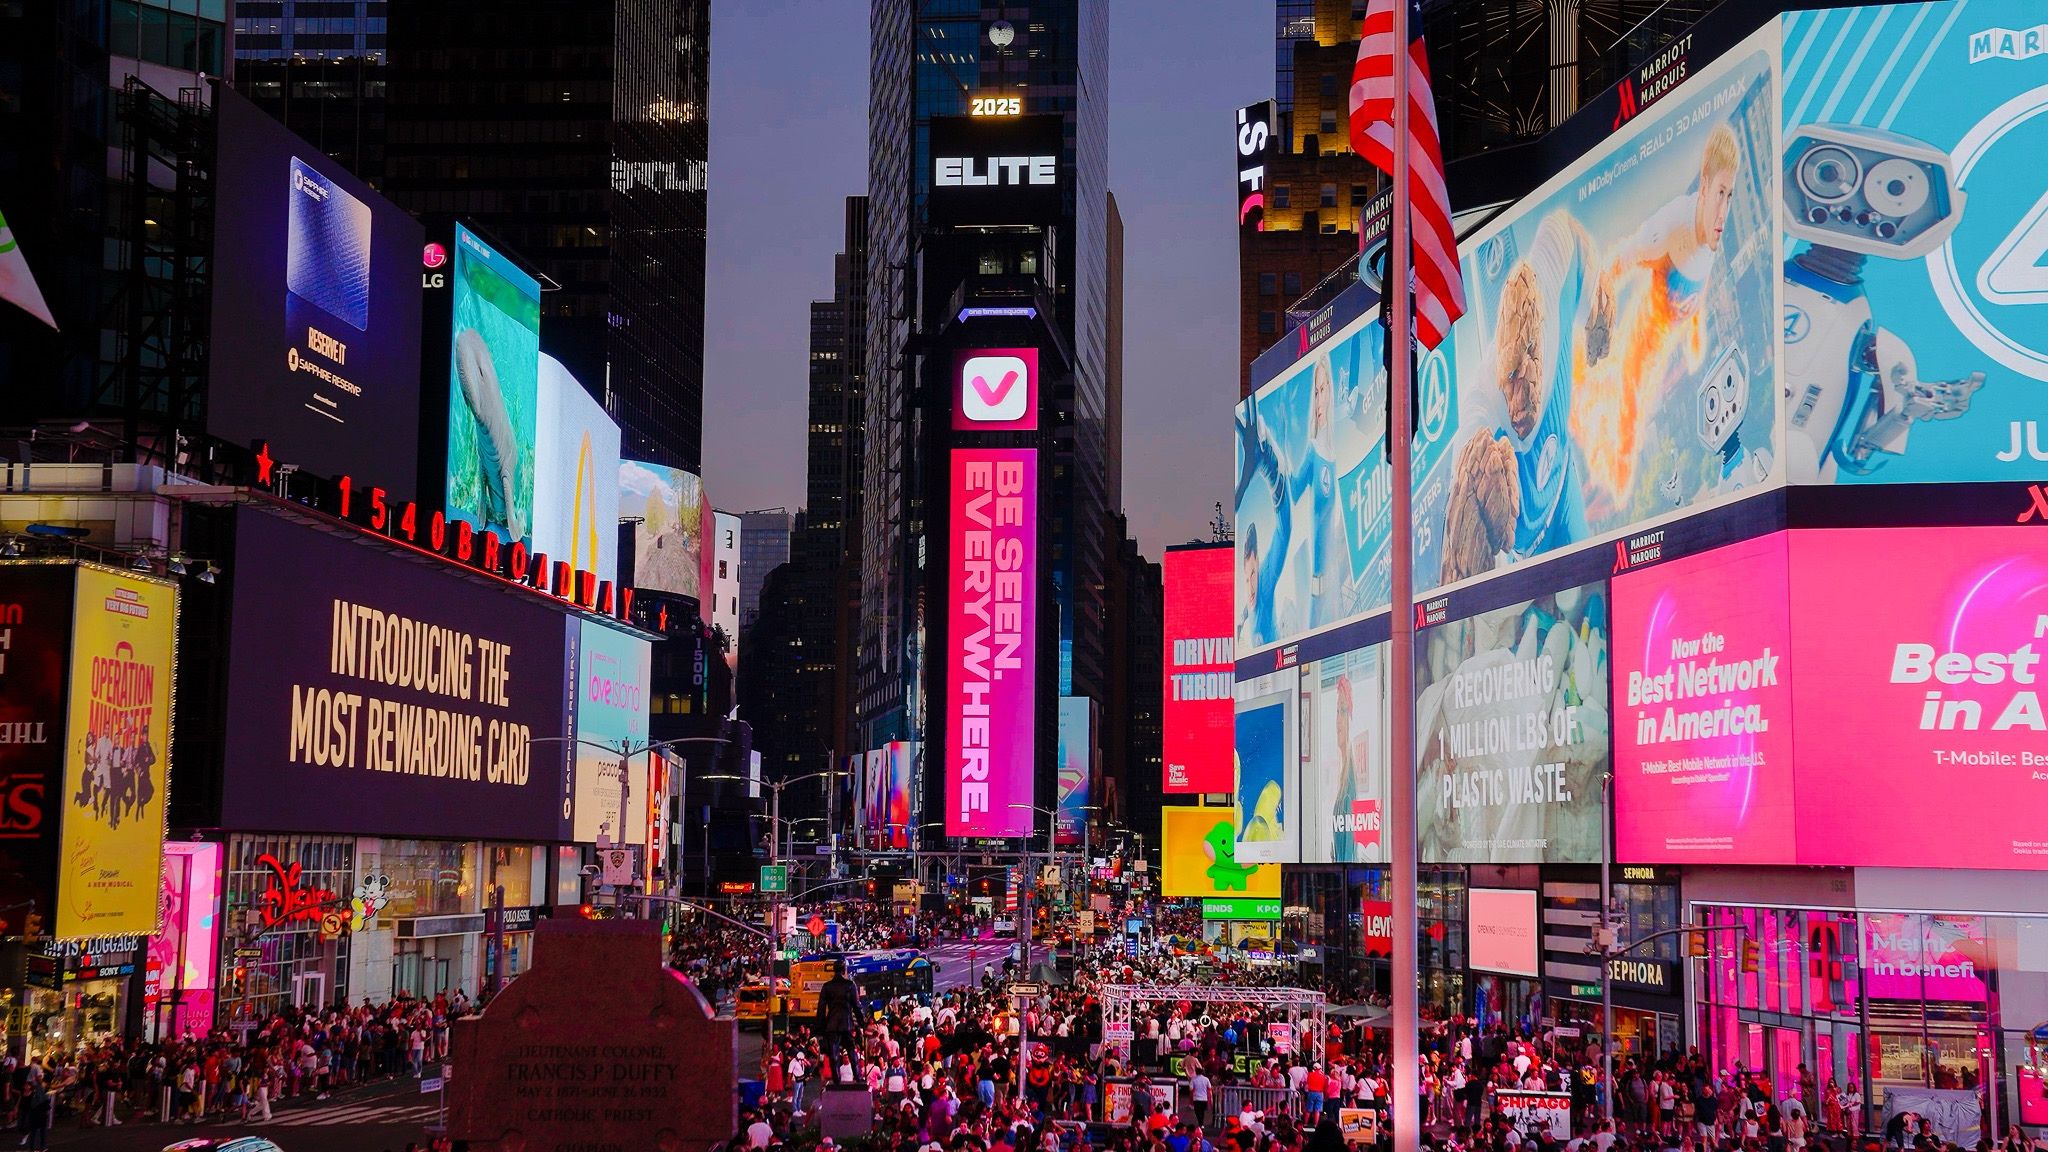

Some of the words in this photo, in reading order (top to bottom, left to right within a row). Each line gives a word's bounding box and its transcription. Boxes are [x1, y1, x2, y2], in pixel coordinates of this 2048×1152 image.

[1641, 34, 1693, 84] MARRIOTT
[1641, 62, 1686, 105] MARQUIS
[972, 98, 1021, 116] 2025
[1578, 187, 1587, 202] IN
[1595, 170, 1614, 191] Dolby
[1676, 116, 1690, 137] 3D
[1691, 103, 1711, 127] AND
[1713, 78, 1747, 112] IMAX
[936, 156, 1056, 186] ELITE
[422, 273, 444, 288] LG
[968, 308, 982, 316] one
[983, 307, 1002, 315] times
[1004, 308, 1028, 316] square
[1310, 305, 1333, 331] MARRIOTT
[309, 327, 339, 362] RESERVE
[339, 342, 347, 366] IT
[1310, 323, 1330, 346] MARQUIS
[299, 358, 332, 383] SAPPHIRE
[996, 461, 1024, 527] BE
[339, 475, 447, 551] 1540
[456, 519, 635, 624] BROADWAY
[1631, 531, 1664, 550] MARRIOTT
[1631, 547, 1661, 565] MARQUIS
[994, 537, 1024, 680] SEEN.
[1427, 598, 1448, 612] MARRIOTT
[1427, 610, 1446, 624] MARQUIS
[331, 599, 473, 700] INTRODUCING
[478, 638, 511, 708] THE
[961, 461, 993, 823] EVERYWHERE.
[1672, 638, 1700, 660] Now
[1702, 632, 1724, 655] the
[692, 637, 703, 686] 1500
[1890, 643, 2040, 685] Best
[92, 656, 155, 708] OPERATION
[589, 650, 612, 704] love
[611, 658, 641, 711] island
[1171, 671, 1234, 701] THROU
[1456, 655, 1554, 709] RECOVERING
[1628, 665, 1674, 707] Best
[1677, 648, 1779, 699] Network
[1637, 711, 1656, 745] in
[1659, 700, 1769, 742] America.
[1920, 691, 1982, 730] in
[1991, 691, 2048, 730] A
[290, 684, 362, 768] MOST
[366, 697, 483, 782] REWARDING
[487, 718, 531, 786] CARD
[1439, 727, 1445, 760] 1
[1451, 718, 1511, 760] MILLION
[1516, 710, 1548, 750] LBS
[1553, 706, 1578, 747] OF
[1169, 763, 1185, 773] Save
[1641, 761, 1668, 775] T-Mobile:
[1668, 759, 1682, 772] Best
[1682, 758, 1704, 772] Mobile
[1704, 755, 1732, 770] Network
[1739, 753, 1753, 766] the
[1933, 750, 2016, 766] T-Mobile:
[597, 761, 619, 785] peaco
[1443, 768, 1504, 809] PLASTIC
[1508, 763, 1573, 804] WASTE.
[1624, 867, 1654, 880] SEPHORA
[253, 853, 337, 925] Disney
[87, 936, 139, 955] LUGGAGE
[100, 967, 119, 977] SONY
[1608, 959, 1664, 985] SEPHORA
[1874, 959, 1895, 976] in
[1586, 986, 1595, 995] 46
[519, 1046, 598, 1059] LIEUTENANT
[602, 1046, 666, 1059] COLONEL
[507, 1064, 586, 1081] FRANCIS
[592, 1064, 604, 1081] P
[612, 1063, 678, 1081] DUFFY
[516, 1087, 540, 1098] MAY
[1499, 1097, 1570, 1110] CHICAGO
[527, 1109, 594, 1122] CATHOLIC
[605, 1109, 655, 1122] PRIEST
